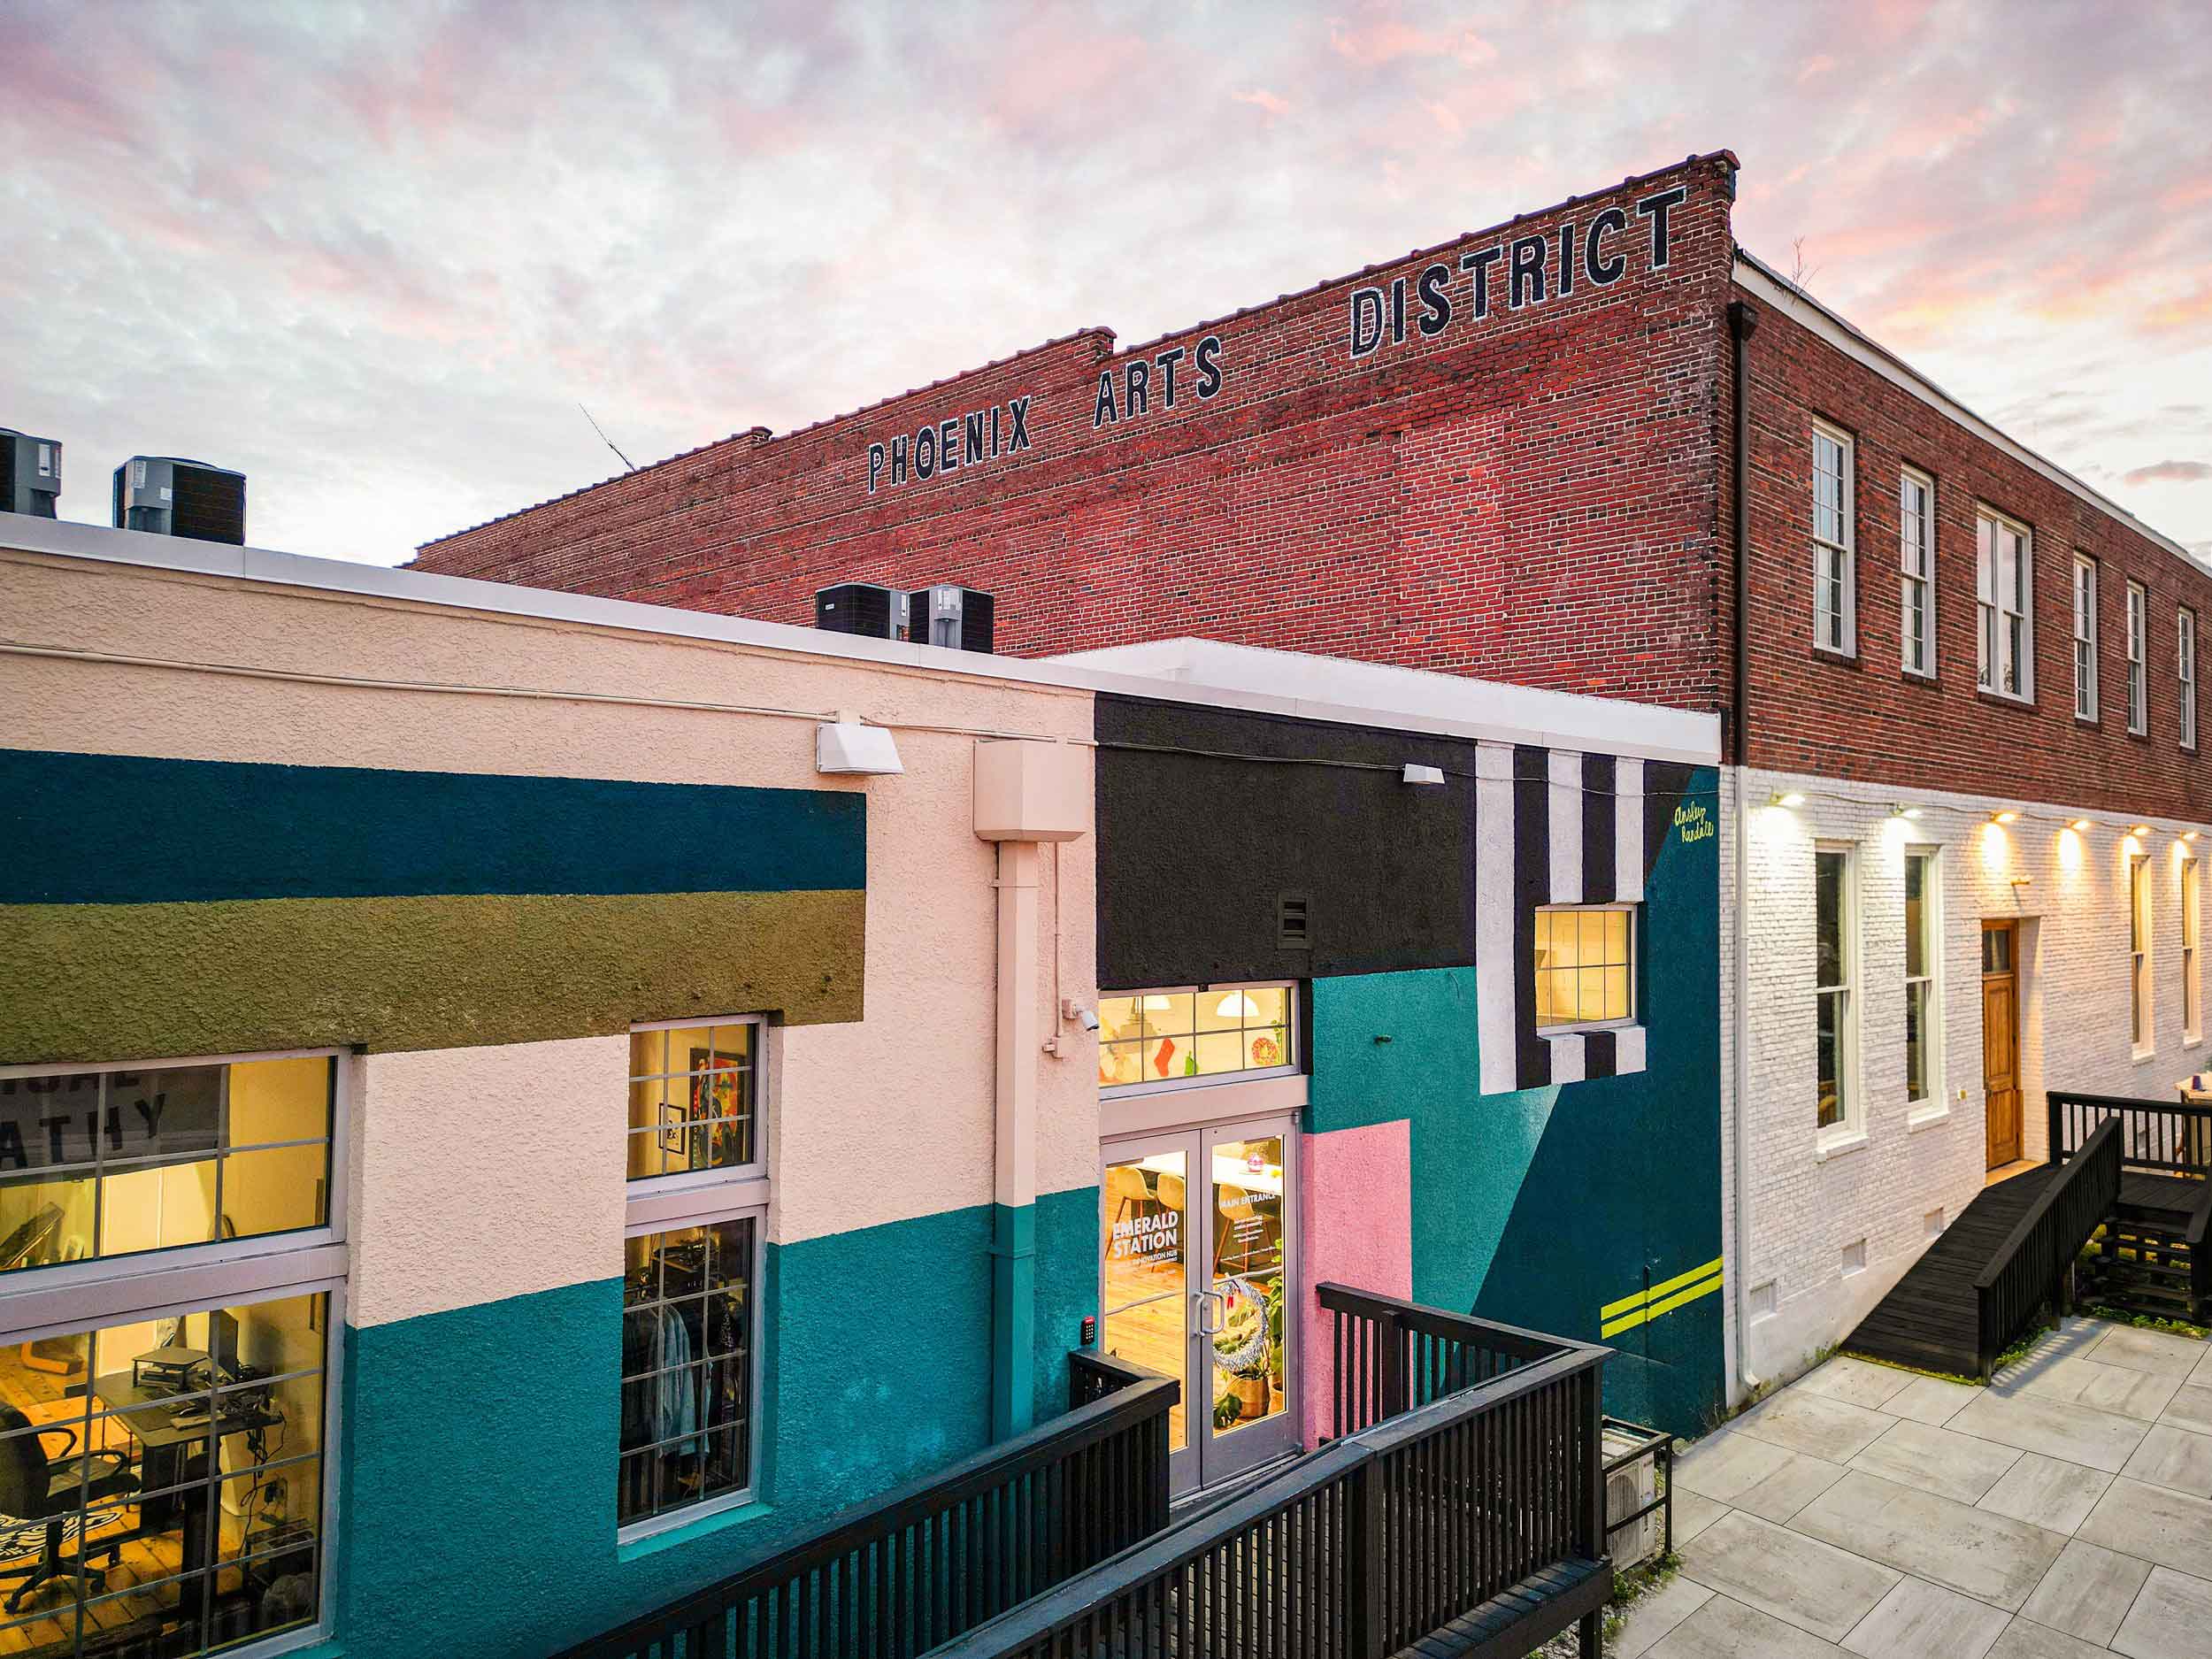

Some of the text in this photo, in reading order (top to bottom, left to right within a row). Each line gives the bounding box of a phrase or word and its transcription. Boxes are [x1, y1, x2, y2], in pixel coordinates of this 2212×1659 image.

[868, 186, 1687, 495] PHOENIX ARTS DISTRICT
[1241, 1189, 1276, 1204] ENTRANCE
[1113, 1210, 1179, 1240] EMERALD
[1114, 1228, 1178, 1258] STATION
[1133, 1252, 1166, 1265] NOVATION
[1166, 1248, 1178, 1257] HUB
